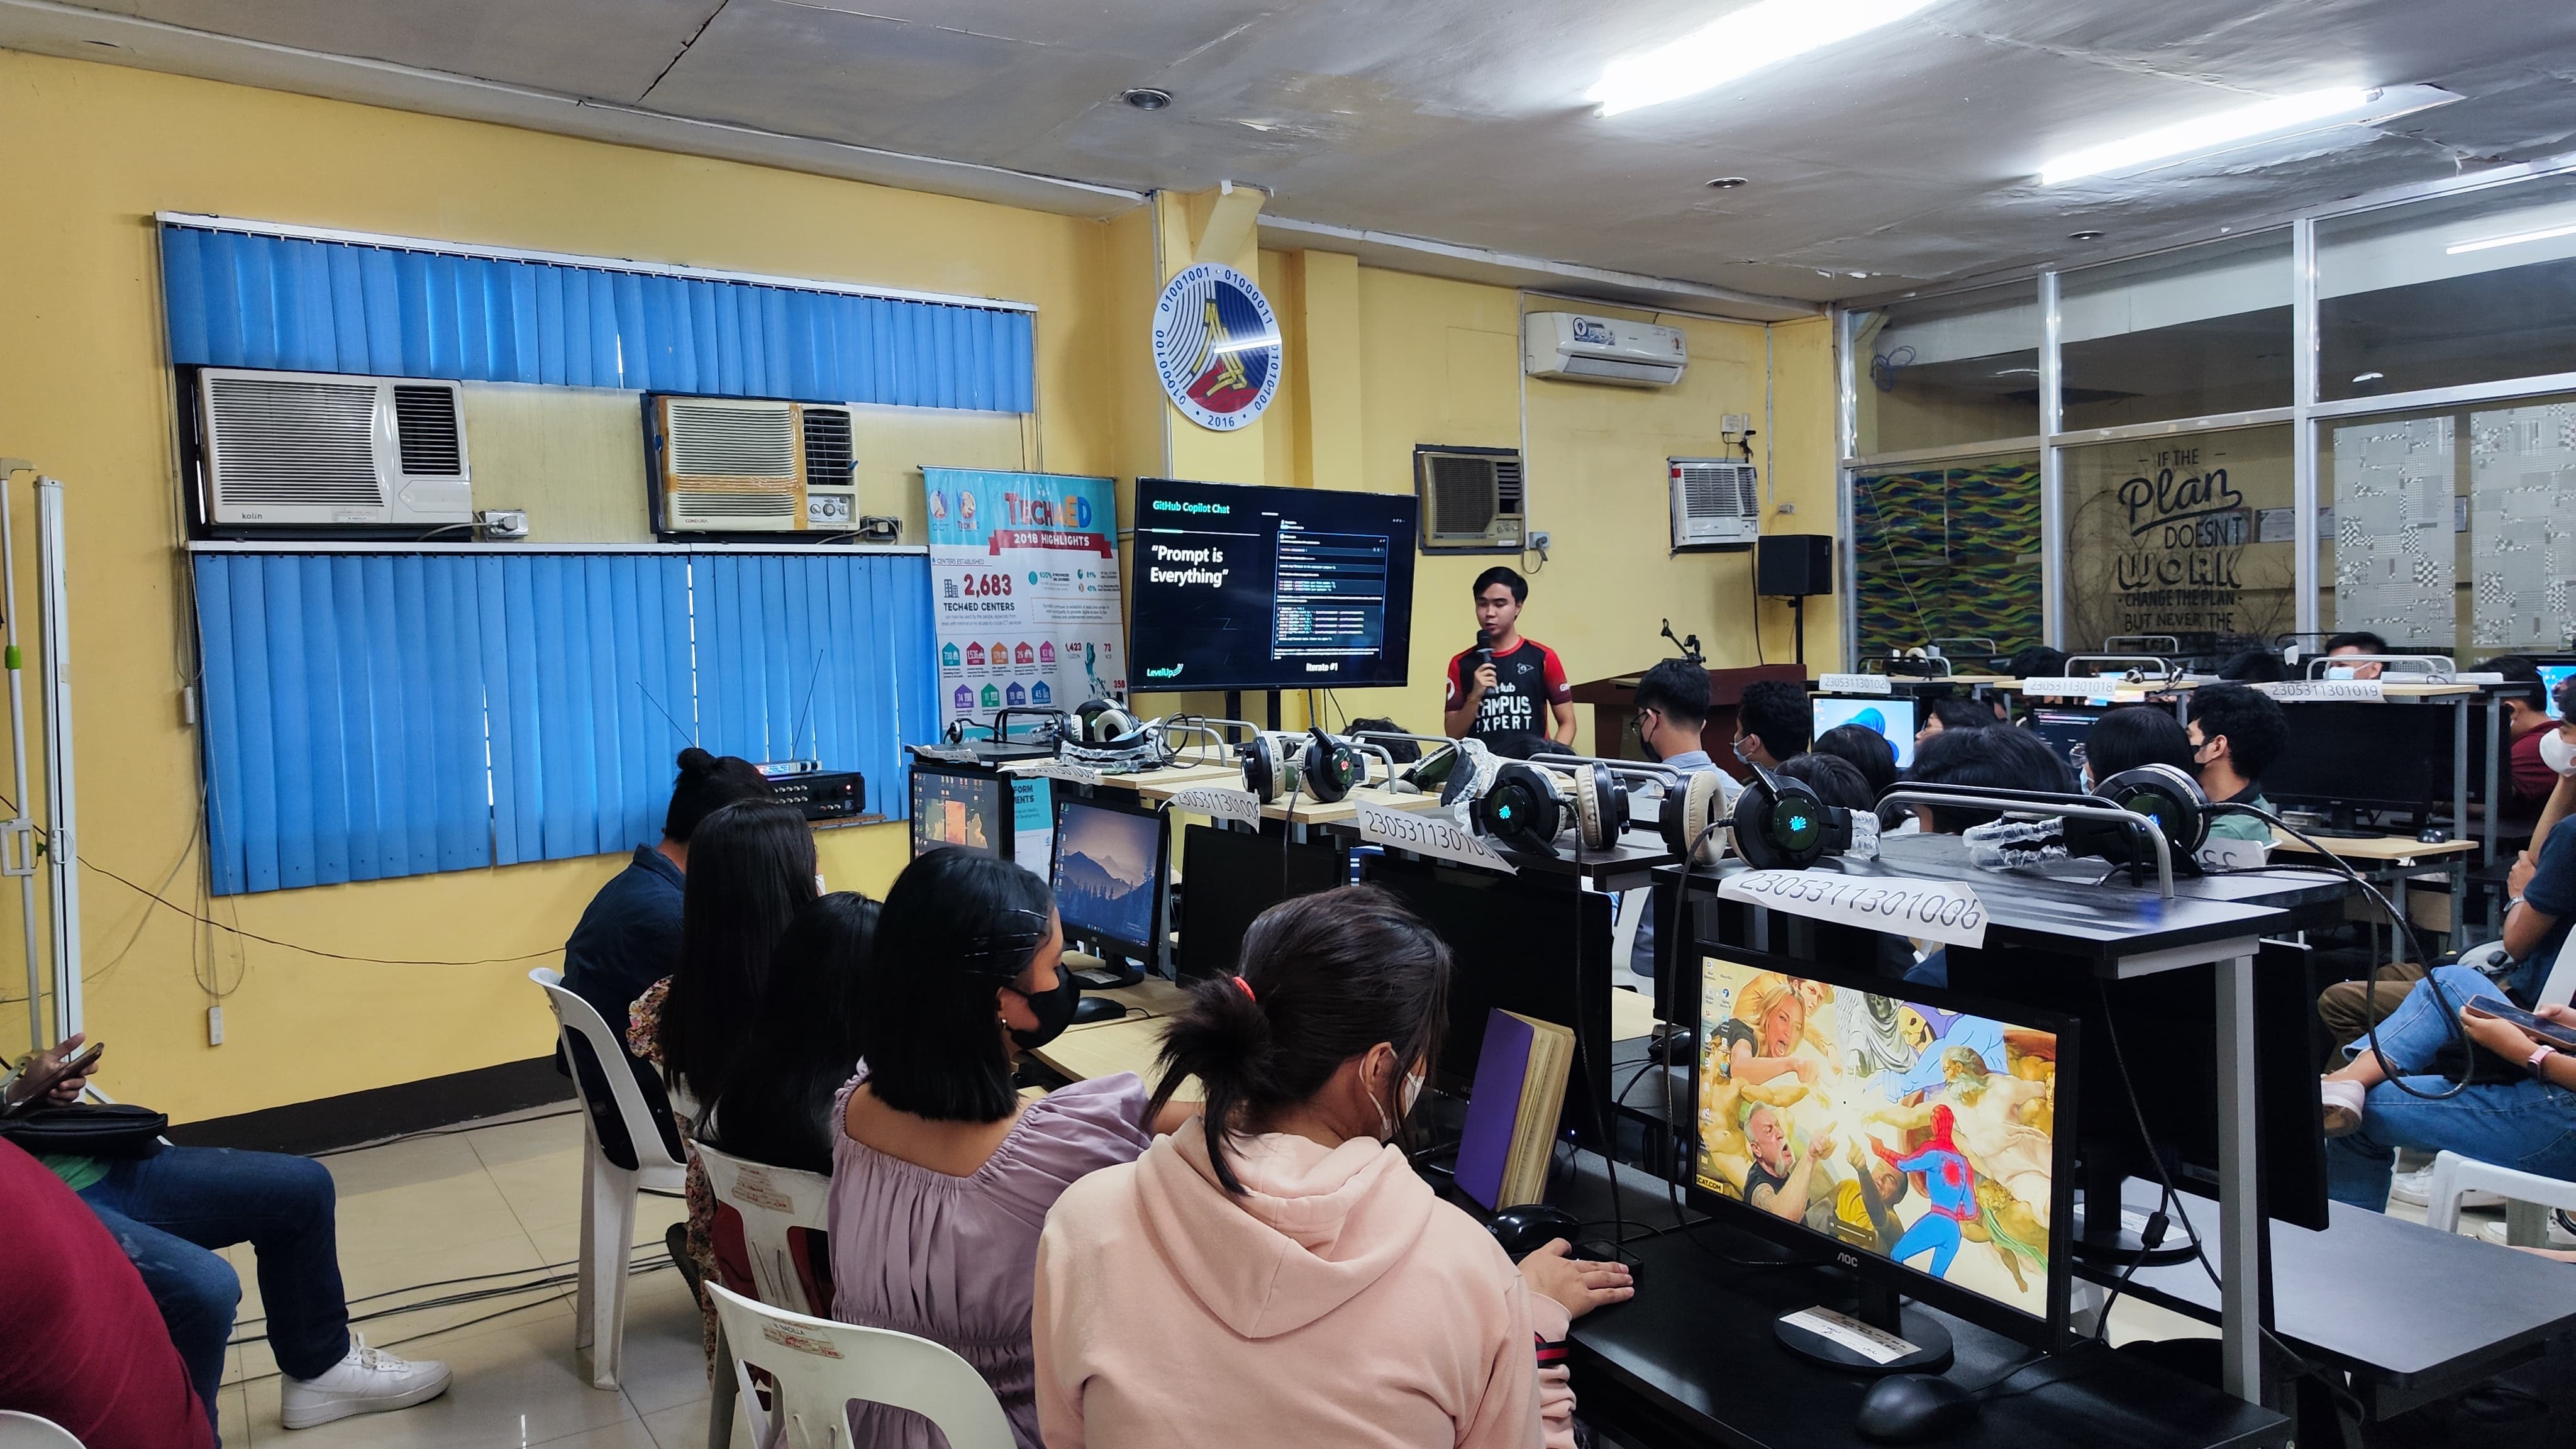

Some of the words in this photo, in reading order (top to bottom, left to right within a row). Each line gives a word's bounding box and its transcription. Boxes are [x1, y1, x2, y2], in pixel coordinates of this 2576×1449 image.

[1208, 414, 1235, 428] 2016
[2158, 452, 2170, 467] IF
[2172, 449, 2199, 465] THE
[2118, 469, 2242, 530] Plan
[1153, 500, 1180, 511] GitHub
[1183, 501, 1211, 514] Copilot
[1212, 502, 1230, 514] Chat
[1014, 533, 1038, 544] 2018
[1041, 534, 1090, 547] HIGHLIGHTS
[1212, 547, 1223, 563] is
[2118, 550, 2242, 591] WORK
[963, 574, 1012, 599] 2,683
[2125, 591, 2172, 607] CHANGE
[2177, 590, 2199, 606] THE
[2201, 590, 2235, 606] PLAN
[943, 602, 979, 611] TECH4ED
[981, 602, 1015, 611] CENTERS
[2125, 613, 2152, 633] BUT
[2157, 613, 2202, 627] NEVER
[2207, 613, 2235, 633] THE
[1065, 642, 1082, 652] 1,423
[1104, 643, 1111, 652] 73
[1017, 650, 1024, 659] 26
[1146, 667, 1174, 678] LevelUp
[1306, 662, 1329, 672] Iterate
[1330, 662, 1338, 672] #1
[1114, 680, 1126, 689] 358
[2030, 680, 2113, 692] 2305311301018
[2270, 685, 2378, 697] 2305311301019
[957, 694, 963, 702] 74
[1035, 690, 1042, 698] 45
[1014, 795, 1035, 804] ENTS
[1739, 872, 1980, 930] 2305311301006
[1696, 1177, 1721, 1192] CAT.COM
[1837, 1252, 1858, 1267] AOC
